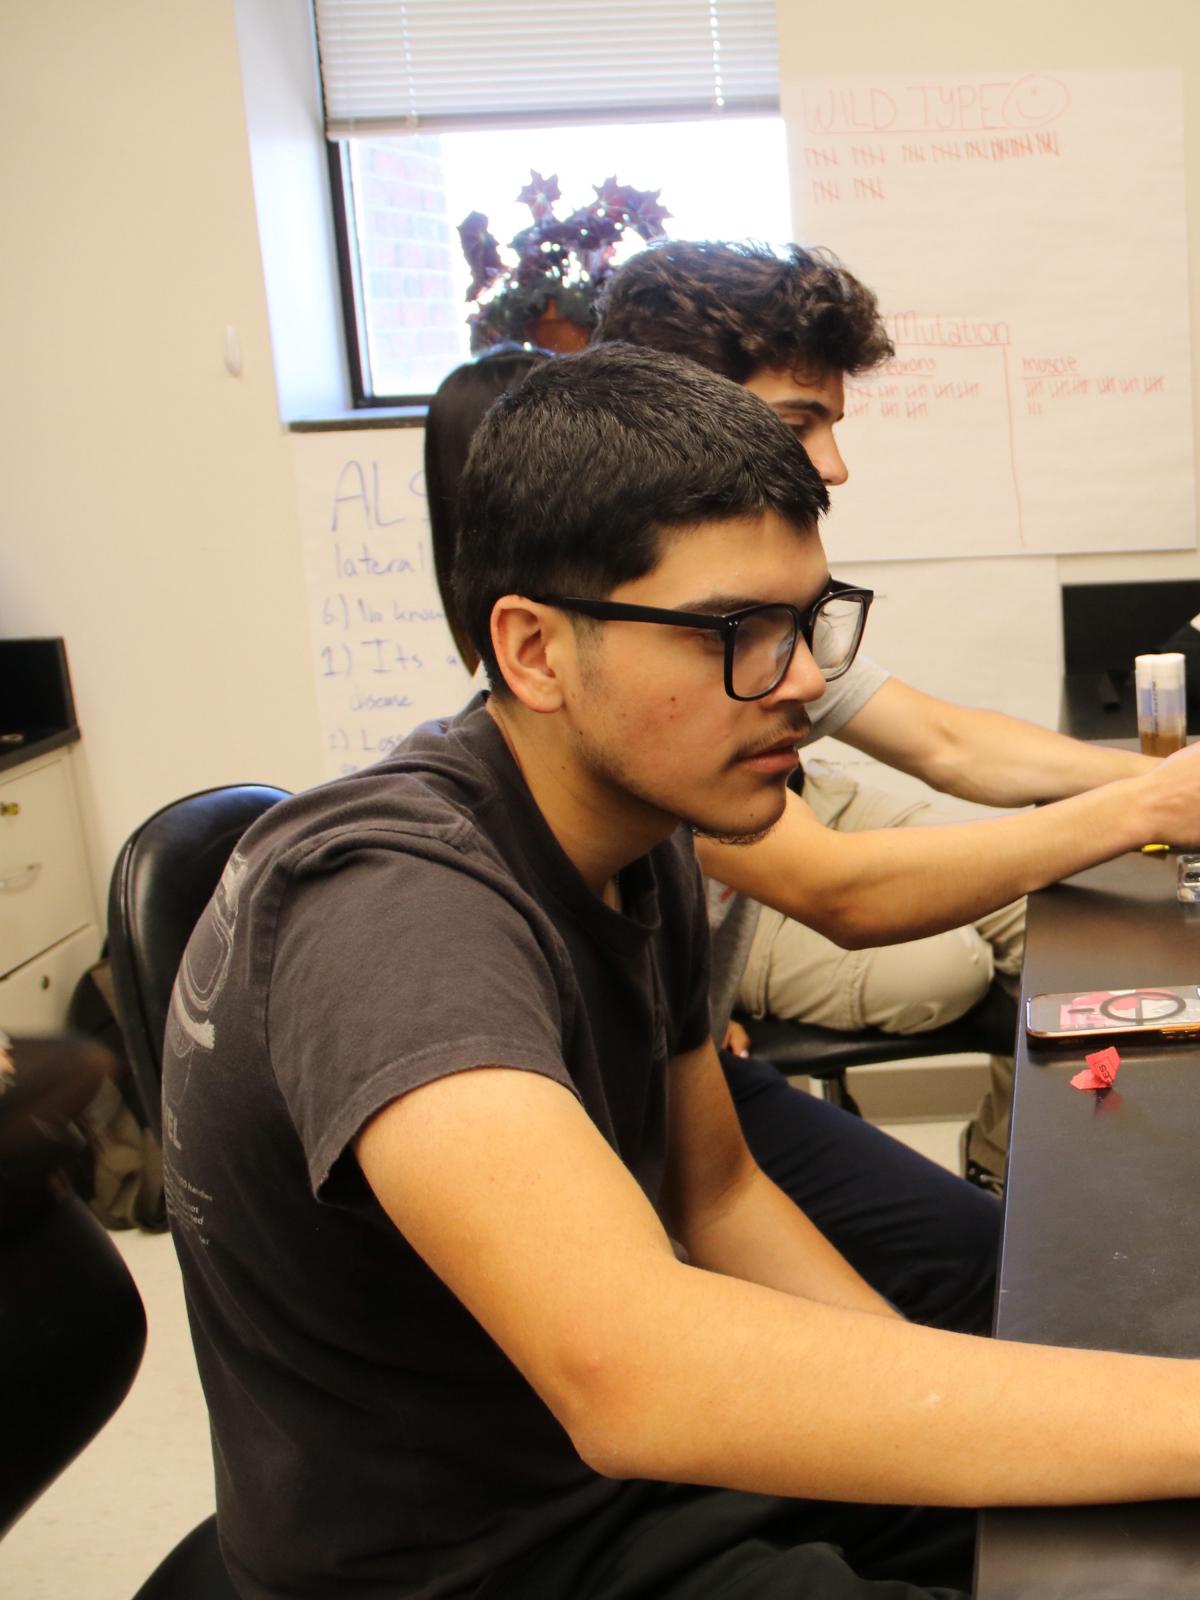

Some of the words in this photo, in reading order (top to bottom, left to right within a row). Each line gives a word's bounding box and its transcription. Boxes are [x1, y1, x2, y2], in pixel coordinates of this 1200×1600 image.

[804, 86, 898, 131] WILD
[908, 83, 1011, 130] TYPE
[893, 310, 1010, 346] Mutation
[1021, 354, 1081, 374] muscle
[334, 542, 426, 580] lateral
